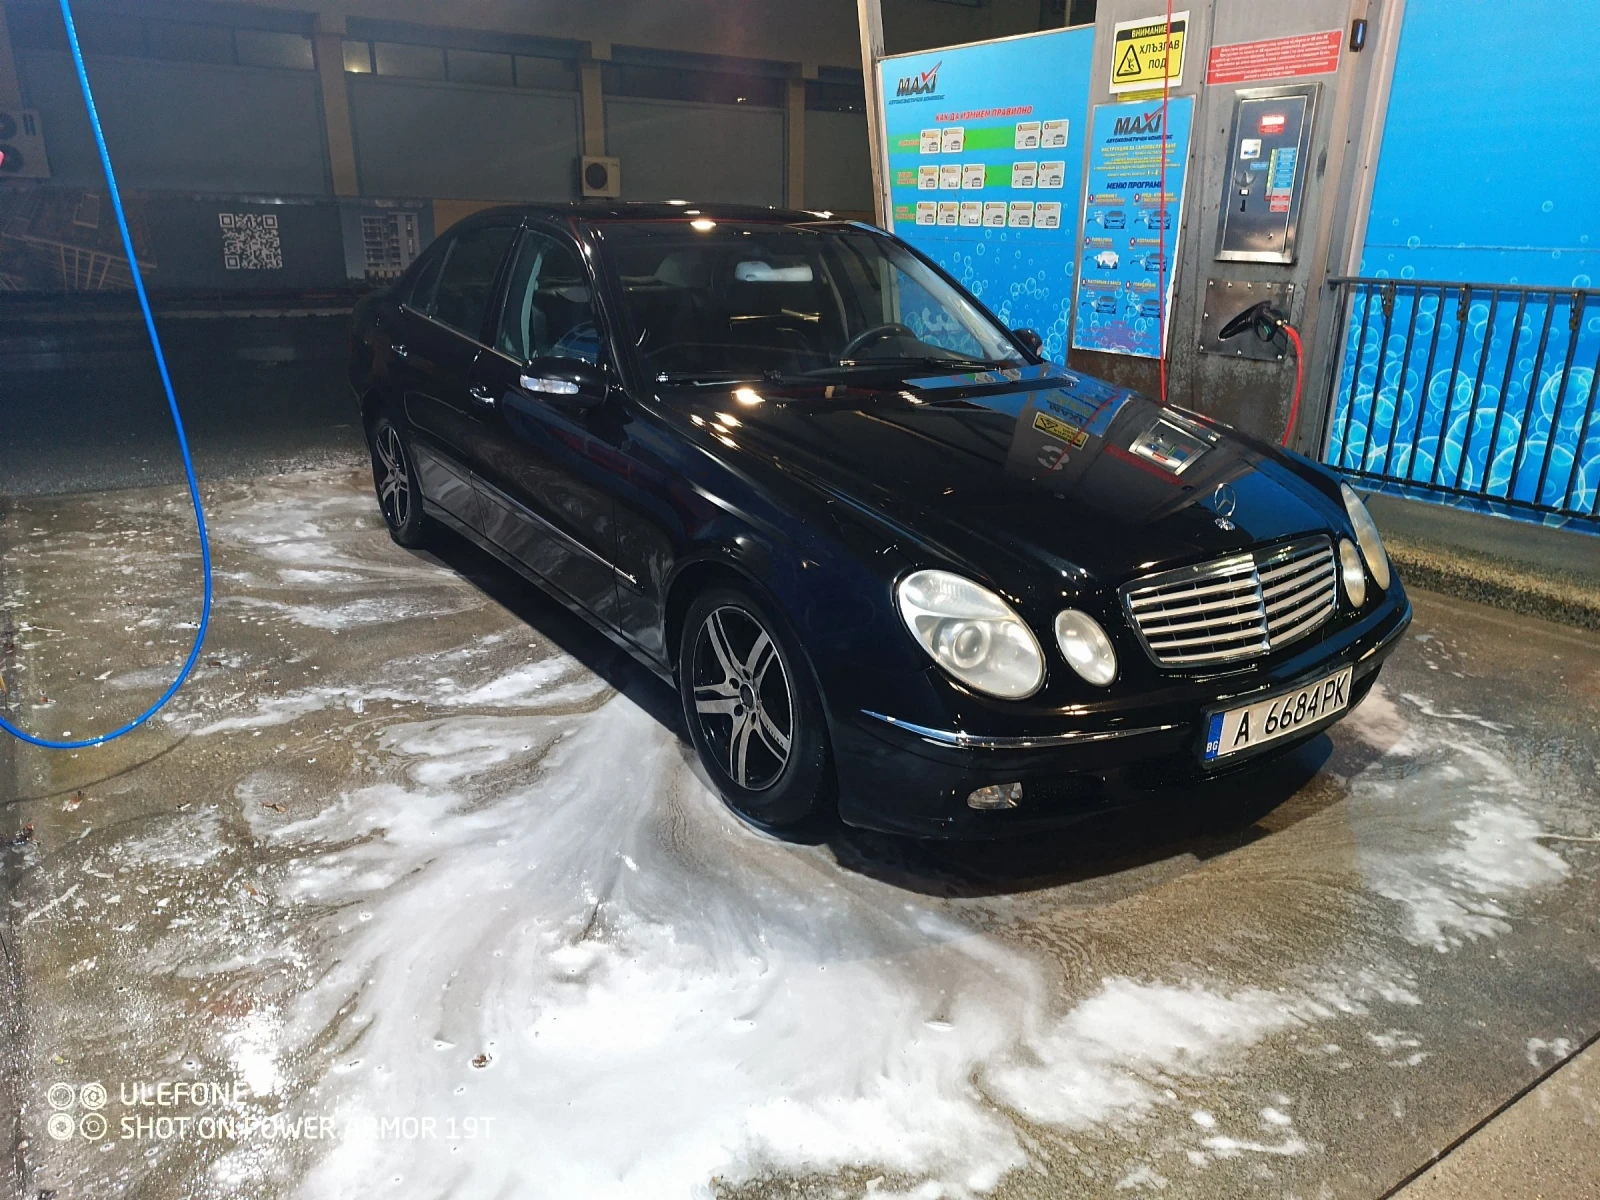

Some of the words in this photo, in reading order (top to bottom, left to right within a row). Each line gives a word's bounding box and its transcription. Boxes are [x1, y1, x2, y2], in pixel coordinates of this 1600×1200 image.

[1131, 24, 1168, 39] ВНИМАНИЕ
[1139, 39, 1180, 54] ХЛЪЗГАВ
[1148, 57, 1168, 69] ПОД
[896, 66, 940, 97] MAXI
[935, 112, 949, 122] КАК
[949, 112, 959, 122] ДА
[960, 109, 991, 120] ИЗМИЕМ
[991, 105, 1033, 117] ПРАВИЛНО
[1113, 109, 1163, 136] MAXI
[1106, 182, 1127, 190] МЕНЮ
[1232, 710, 1249, 746] A
[1206, 741, 1218, 753] BG
